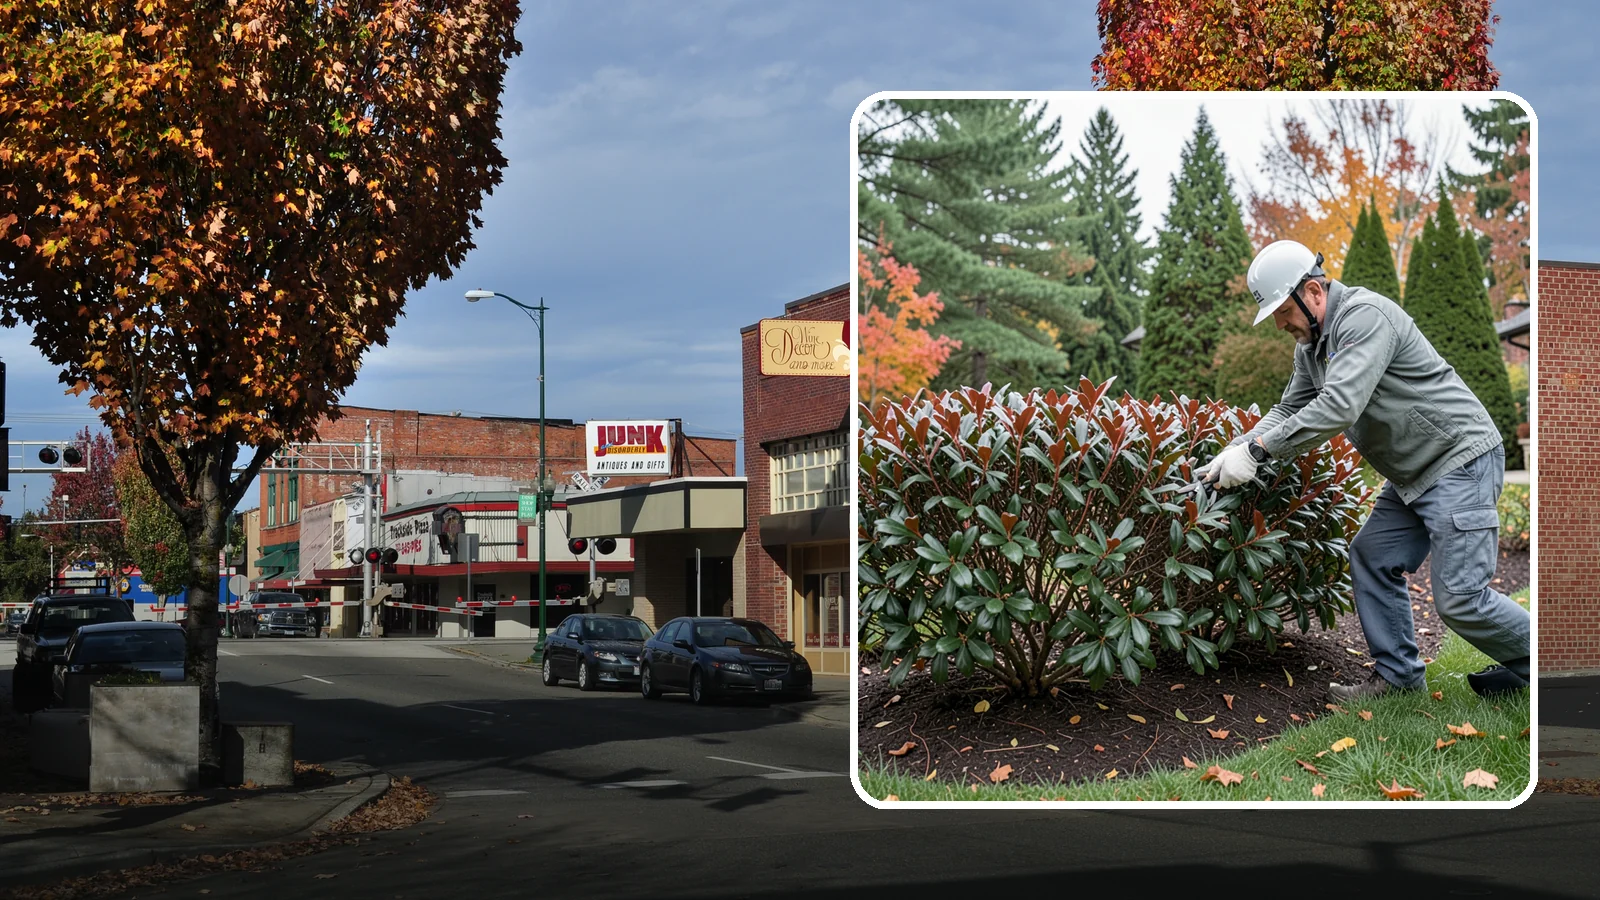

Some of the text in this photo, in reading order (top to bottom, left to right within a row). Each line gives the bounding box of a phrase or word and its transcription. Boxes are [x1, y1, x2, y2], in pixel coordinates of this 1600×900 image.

[595, 425, 665, 457] JUNK
[607, 446, 646, 454] DISORDERLY
[597, 460, 665, 470] ANTIQUES AND GIFTS
[390, 519, 429, 540] Trackside Pizza
